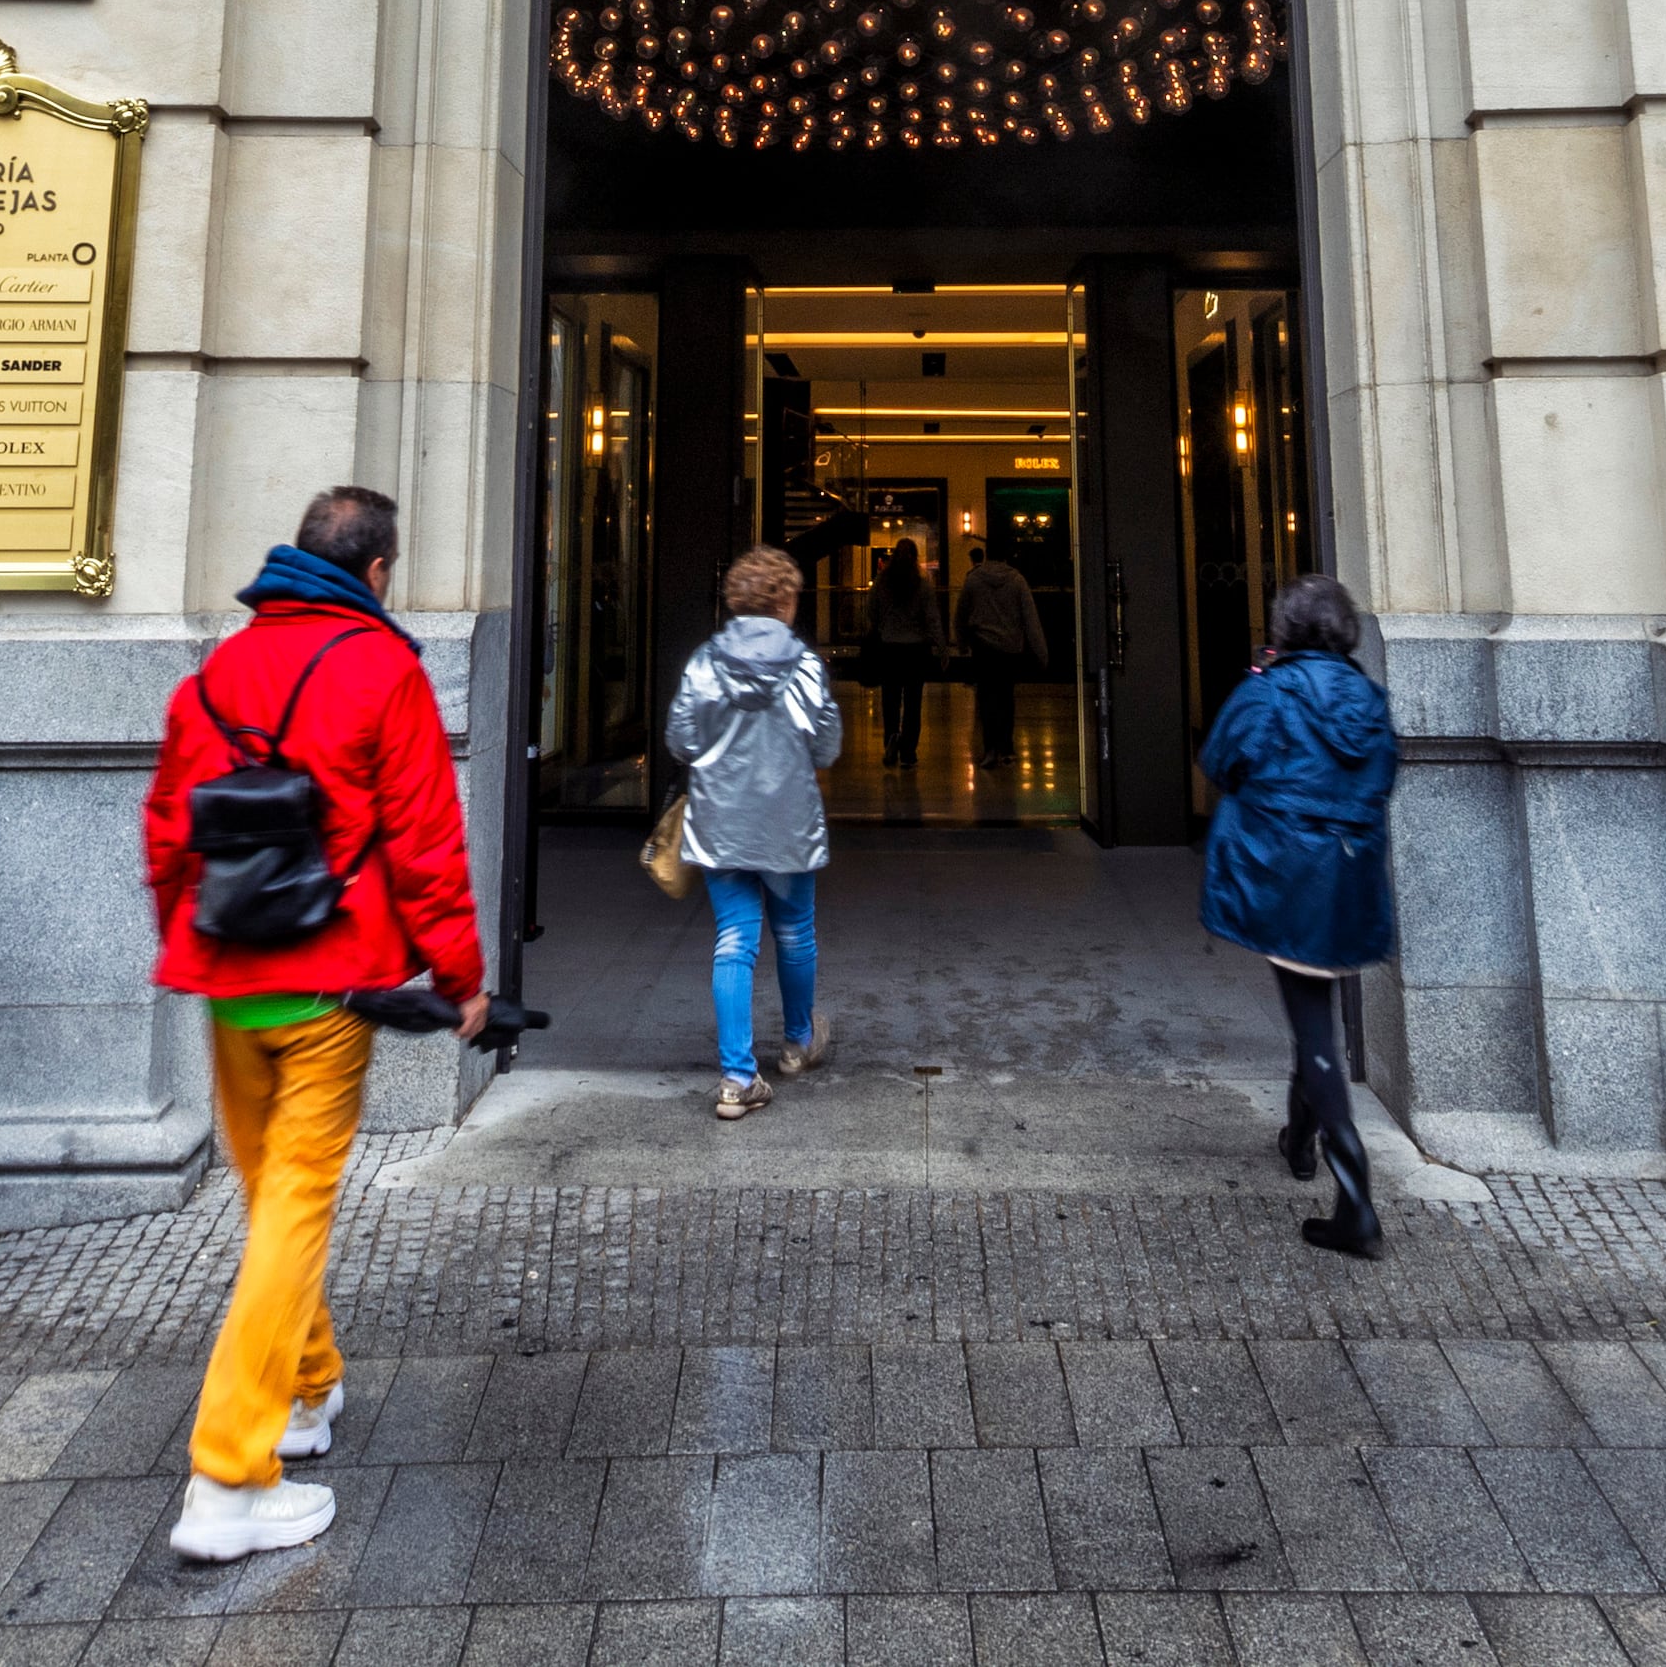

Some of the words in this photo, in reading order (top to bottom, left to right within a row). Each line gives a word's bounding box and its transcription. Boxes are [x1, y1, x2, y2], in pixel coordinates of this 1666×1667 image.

[26, 252, 70, 263] PLANTA
[29, 318, 78, 332] ARMANI
[1, 359, 62, 372] SANDER
[9, 400, 68, 413] VUITTON
[1014, 457, 1061, 470] ROLEX
